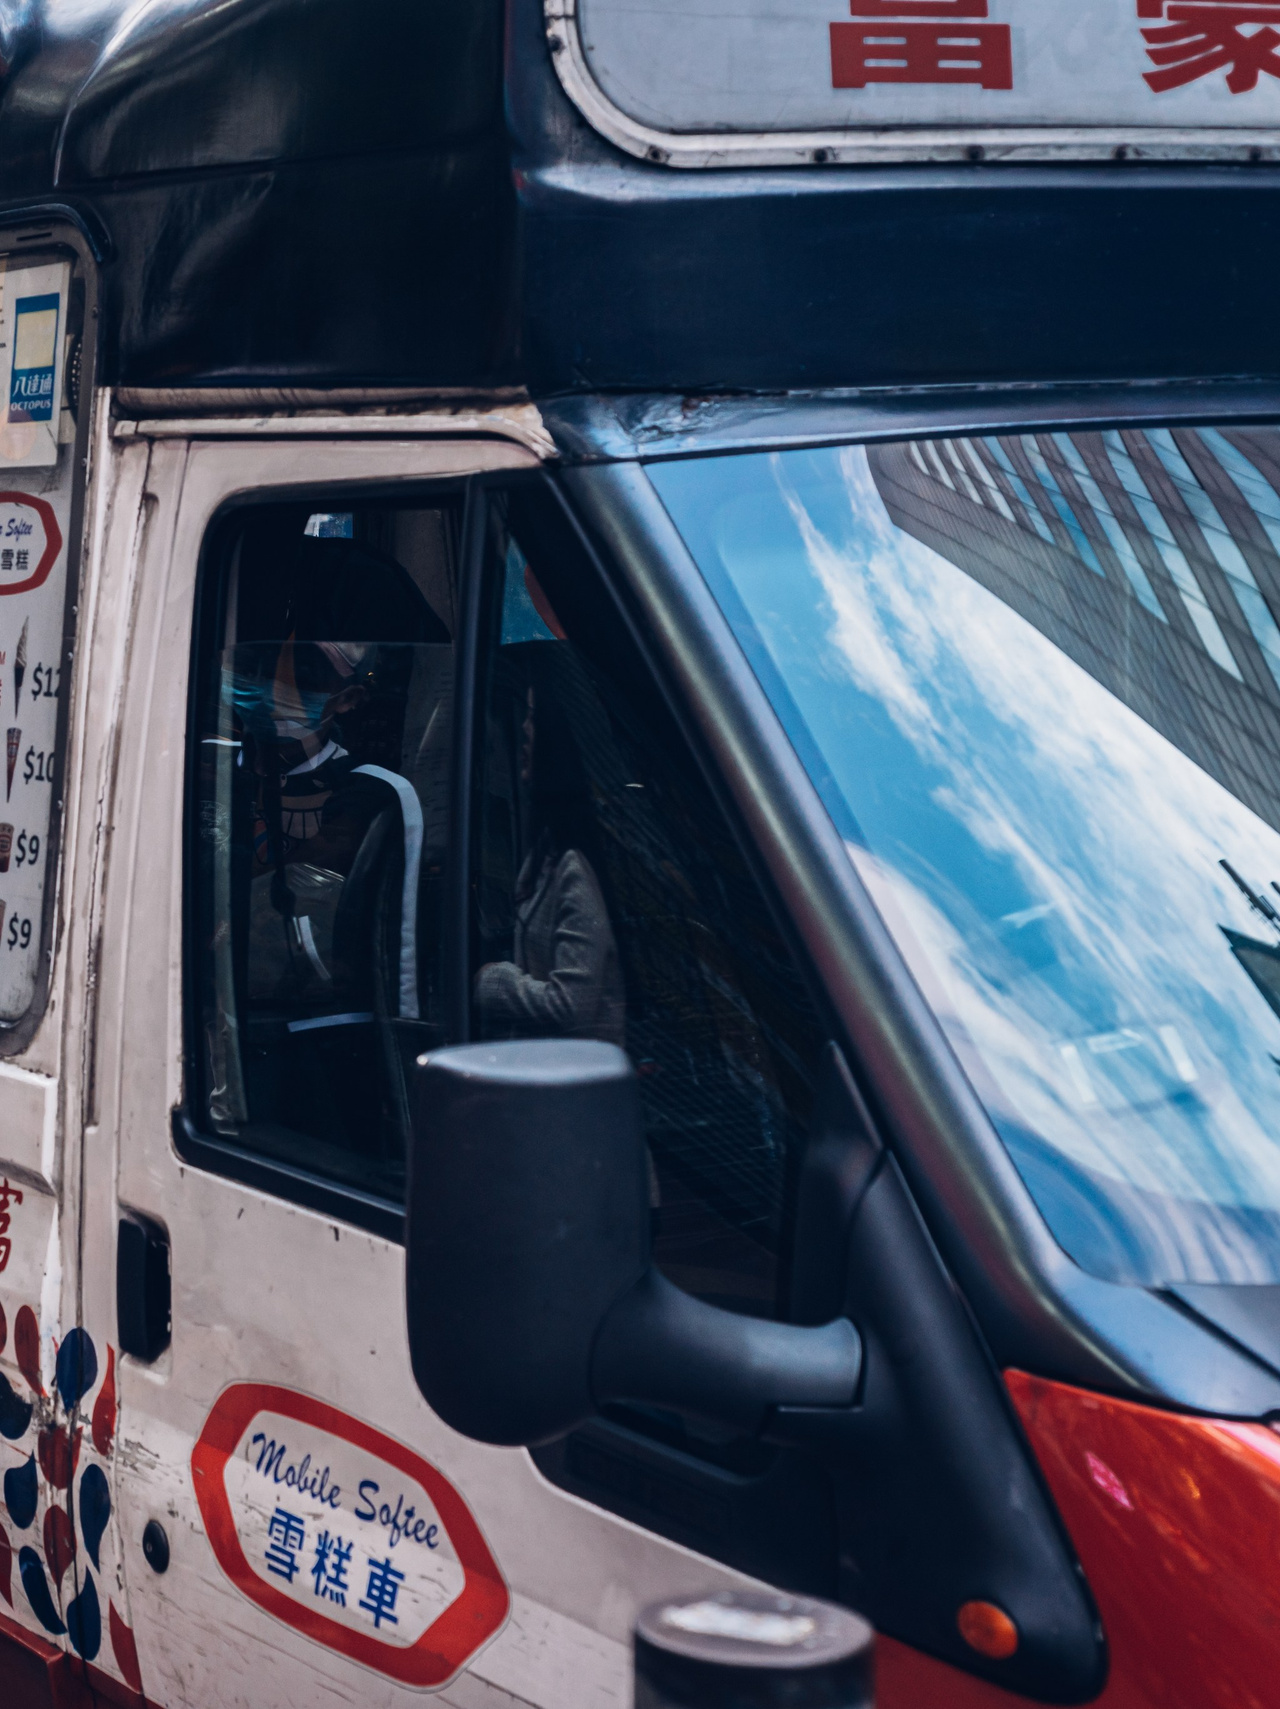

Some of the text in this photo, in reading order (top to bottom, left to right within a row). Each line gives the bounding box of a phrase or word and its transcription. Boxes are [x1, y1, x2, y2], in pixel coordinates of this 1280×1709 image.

[12, 372, 53, 397] 八達通
[10, 398, 51, 412] OCTOPUS
[5, 518, 33, 541] Softee
[23, 745, 55, 785] $10
[15, 829, 40, 867] $9
[8, 912, 32, 951] $9
[252, 1432, 440, 1550] Mobile Softee
[264, 1507, 407, 1629] 雪糕車
